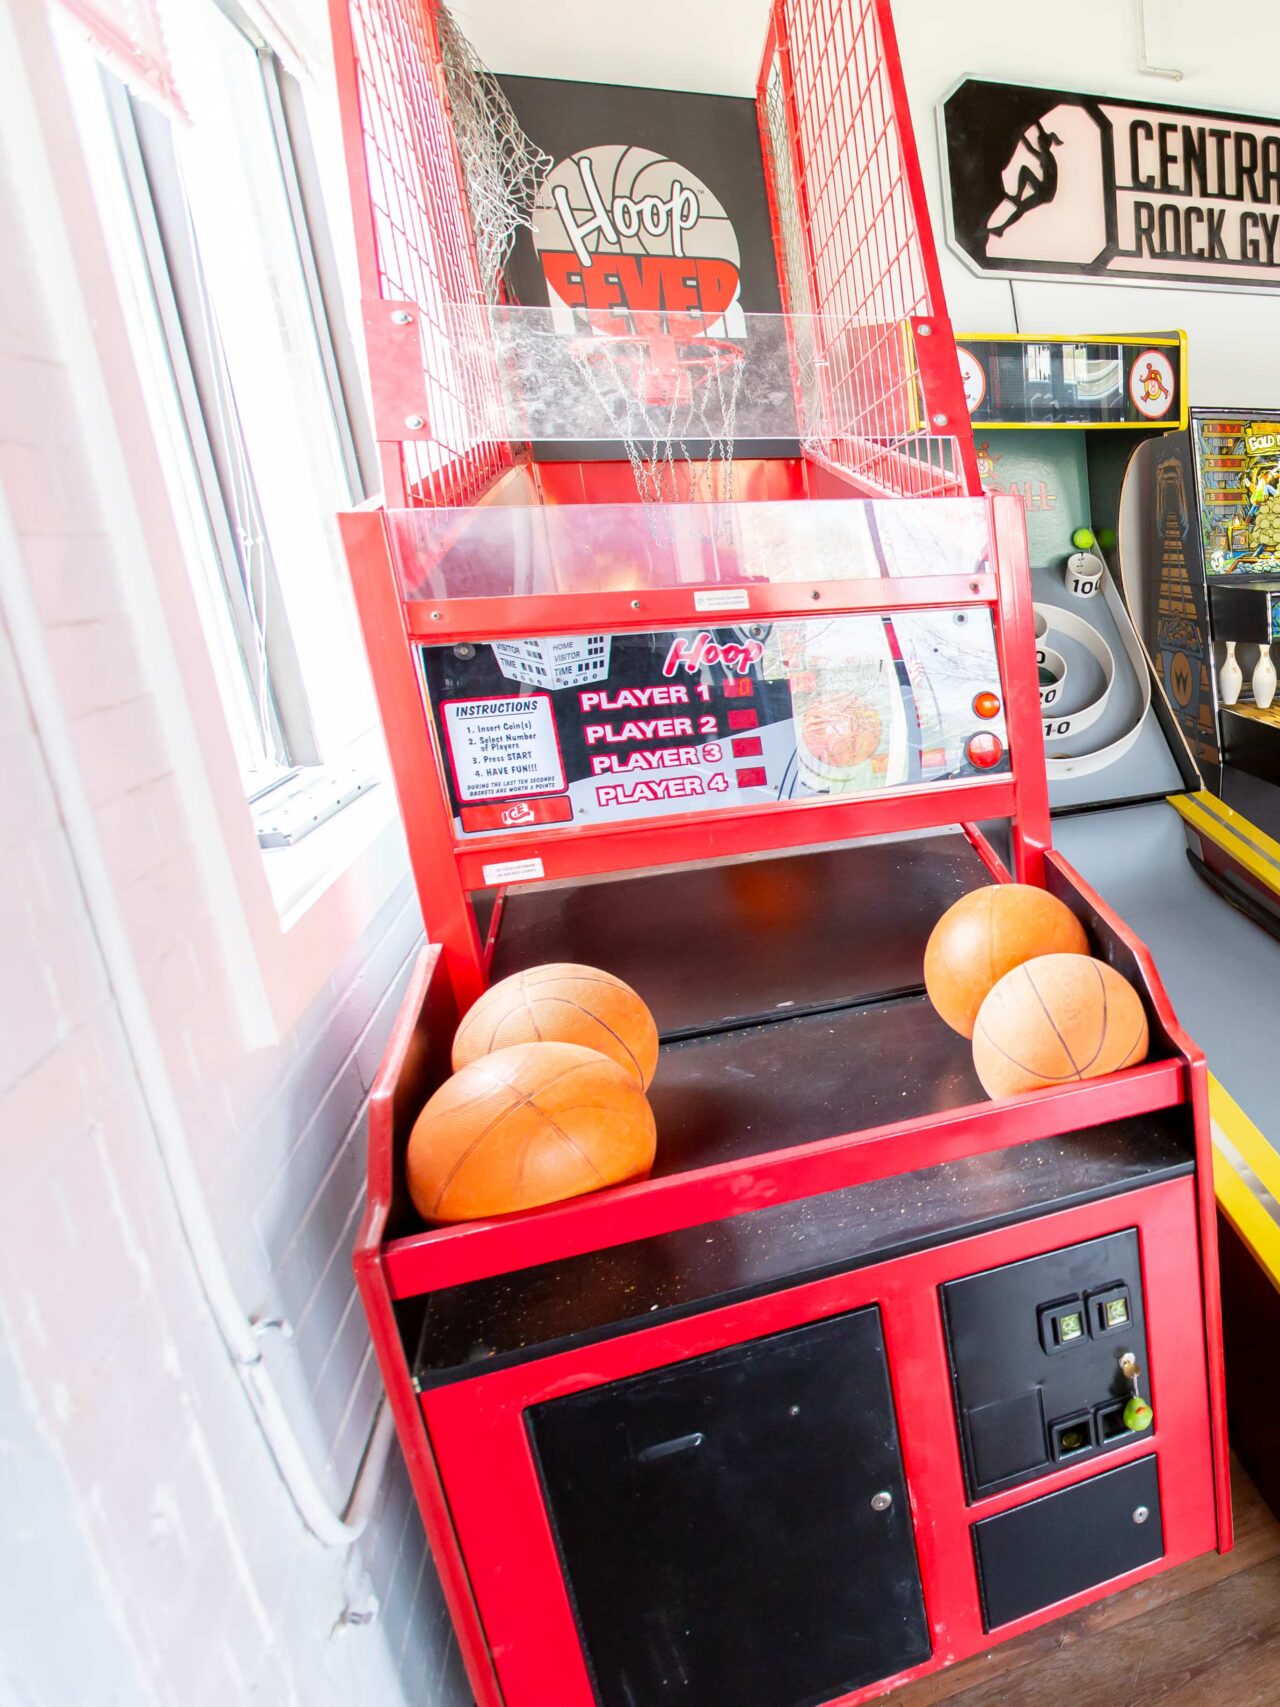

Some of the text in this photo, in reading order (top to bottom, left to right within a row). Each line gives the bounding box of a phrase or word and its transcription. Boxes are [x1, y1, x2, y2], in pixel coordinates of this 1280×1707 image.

[552, 156, 699, 268] Hoop
[1133, 200, 1228, 260] ROCK
[538, 250, 748, 338] FEVER
[1248, 434, 1275, 451] GOLD
[496, 643, 520, 655] VISITOR
[553, 641, 573, 651] HOME
[554, 651, 580, 662] VISITOR
[662, 632, 763, 677] Hoop
[501, 657, 518, 669] TIME
[554, 665, 573, 677] TIME
[579, 684, 711, 712] PLAYER 1
[456, 700, 538, 718] INSTRUCTIONS
[467, 720, 532, 734] 1. Insert Coin(s)
[585, 715, 718, 745] PLAYER 2
[1044, 721, 1071, 737] 10
[479, 736, 503, 745] Select
[506, 733, 536, 742] Number
[480, 742, 519, 752] of Players
[483, 755, 505, 764] Press
[506, 751, 532, 761] START
[590, 743, 723, 775] PLAYER 3
[486, 766, 509, 776] HAVE
[511, 764, 537, 774] FUN!!!
[467, 782, 489, 790] DURING
[470, 789, 494, 797] BASKETS
[596, 772, 728, 806] PLAYER 4
[503, 804, 529, 822] ICE
